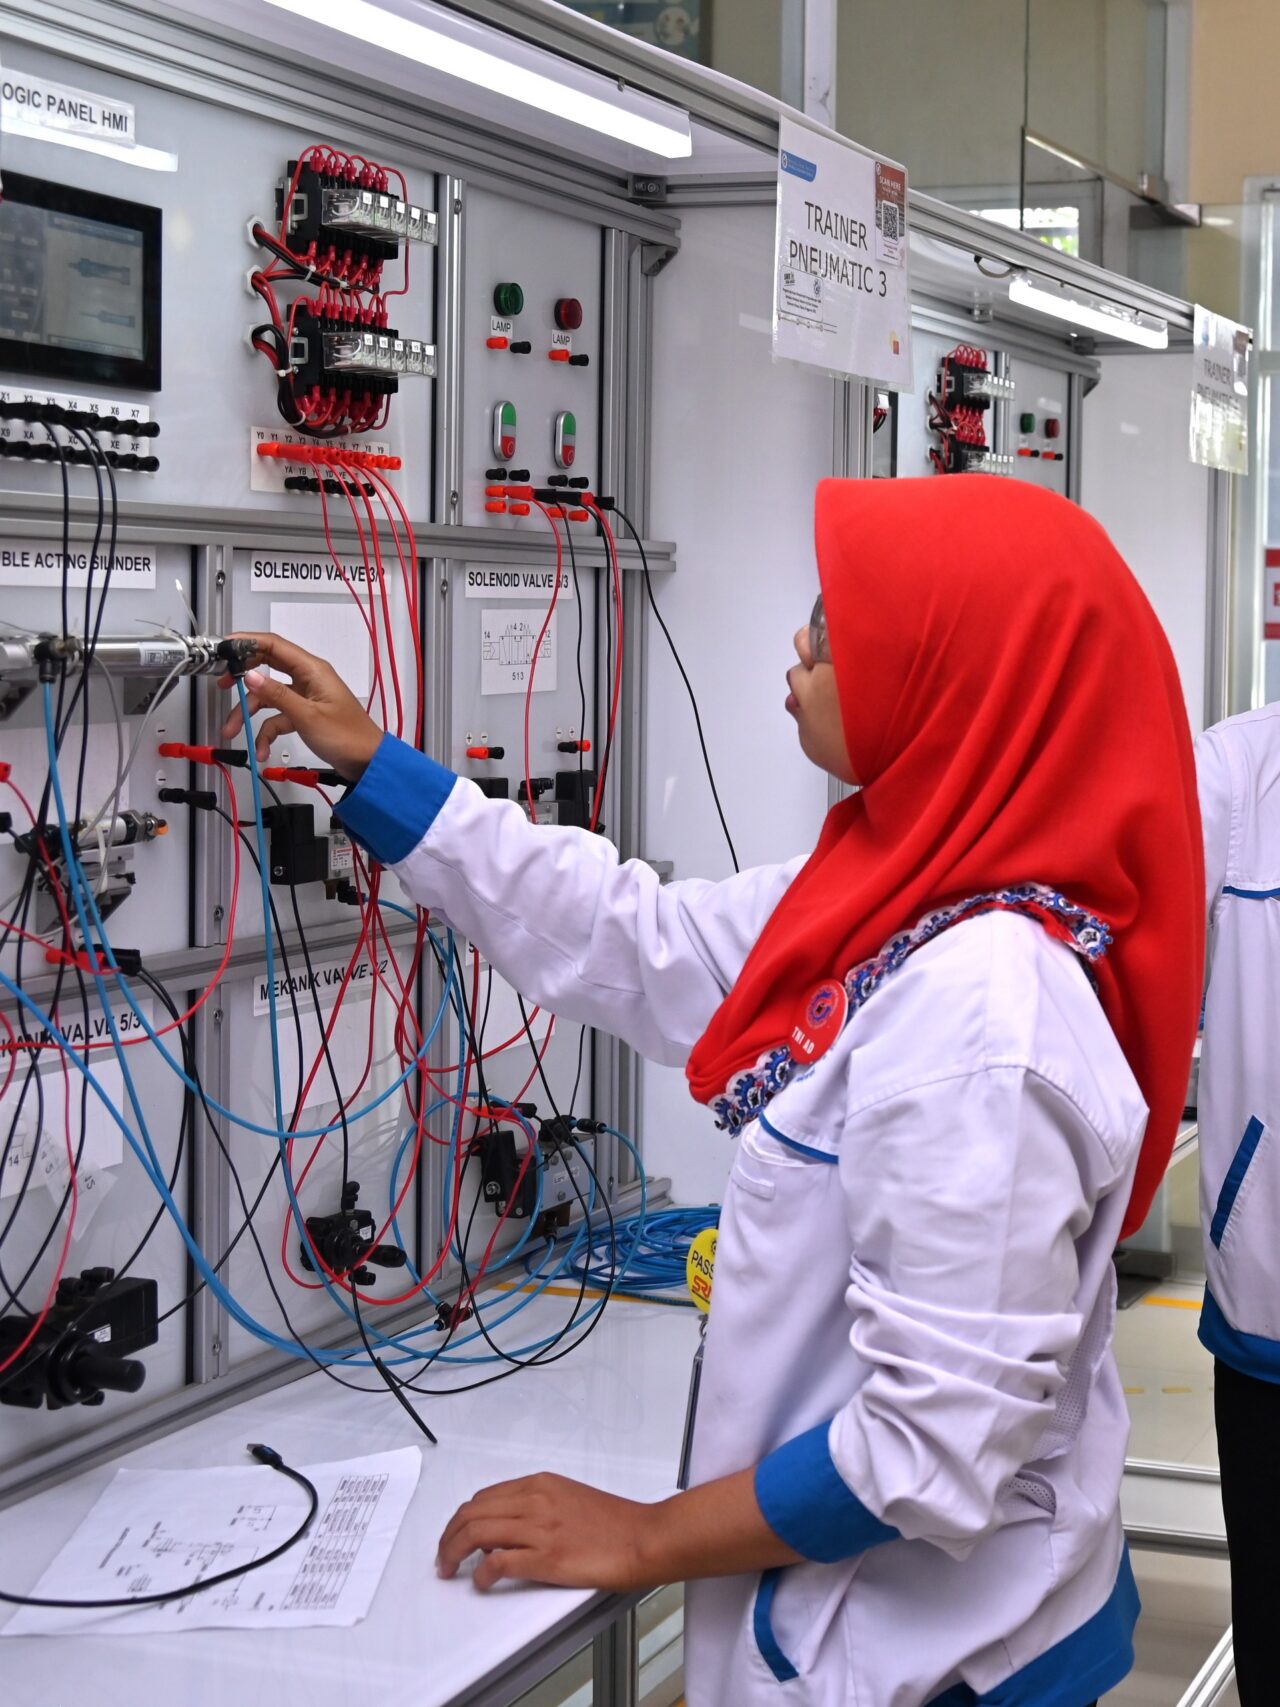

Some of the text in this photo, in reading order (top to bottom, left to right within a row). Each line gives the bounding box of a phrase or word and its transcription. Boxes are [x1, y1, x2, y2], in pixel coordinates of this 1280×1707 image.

[46, 95, 98, 124] PANEL
[102, 110, 128, 132] HMI
[804, 200, 868, 251] TRAINER
[789, 240, 887, 297] PNEUMATIC 3
[492, 321, 511, 332] LAMP
[553, 334, 570, 345] LAMP
[111, 406, 120, 416] X6
[131, 409, 140, 418] X7
[24, 431, 34, 440] XA
[111, 440, 120, 449] XE
[131, 443, 140, 451] XF
[284, 466, 293, 474] YA
[34, 553, 87, 570] ACTNG
[92, 554, 151, 572] SILINDER
[254, 561, 322, 580] SOLENOID
[325, 564, 366, 582] VALVE
[468, 571, 569, 588] SOLENOID VALVE /3
[484, 631, 491, 639] 14
[260, 959, 388, 1001] MEKANIK VALVE /2
[61, 1016, 115, 1042] VALVE
[120, 1011, 141, 1032] 5/3
[791, 1025, 805, 1045] TNI
